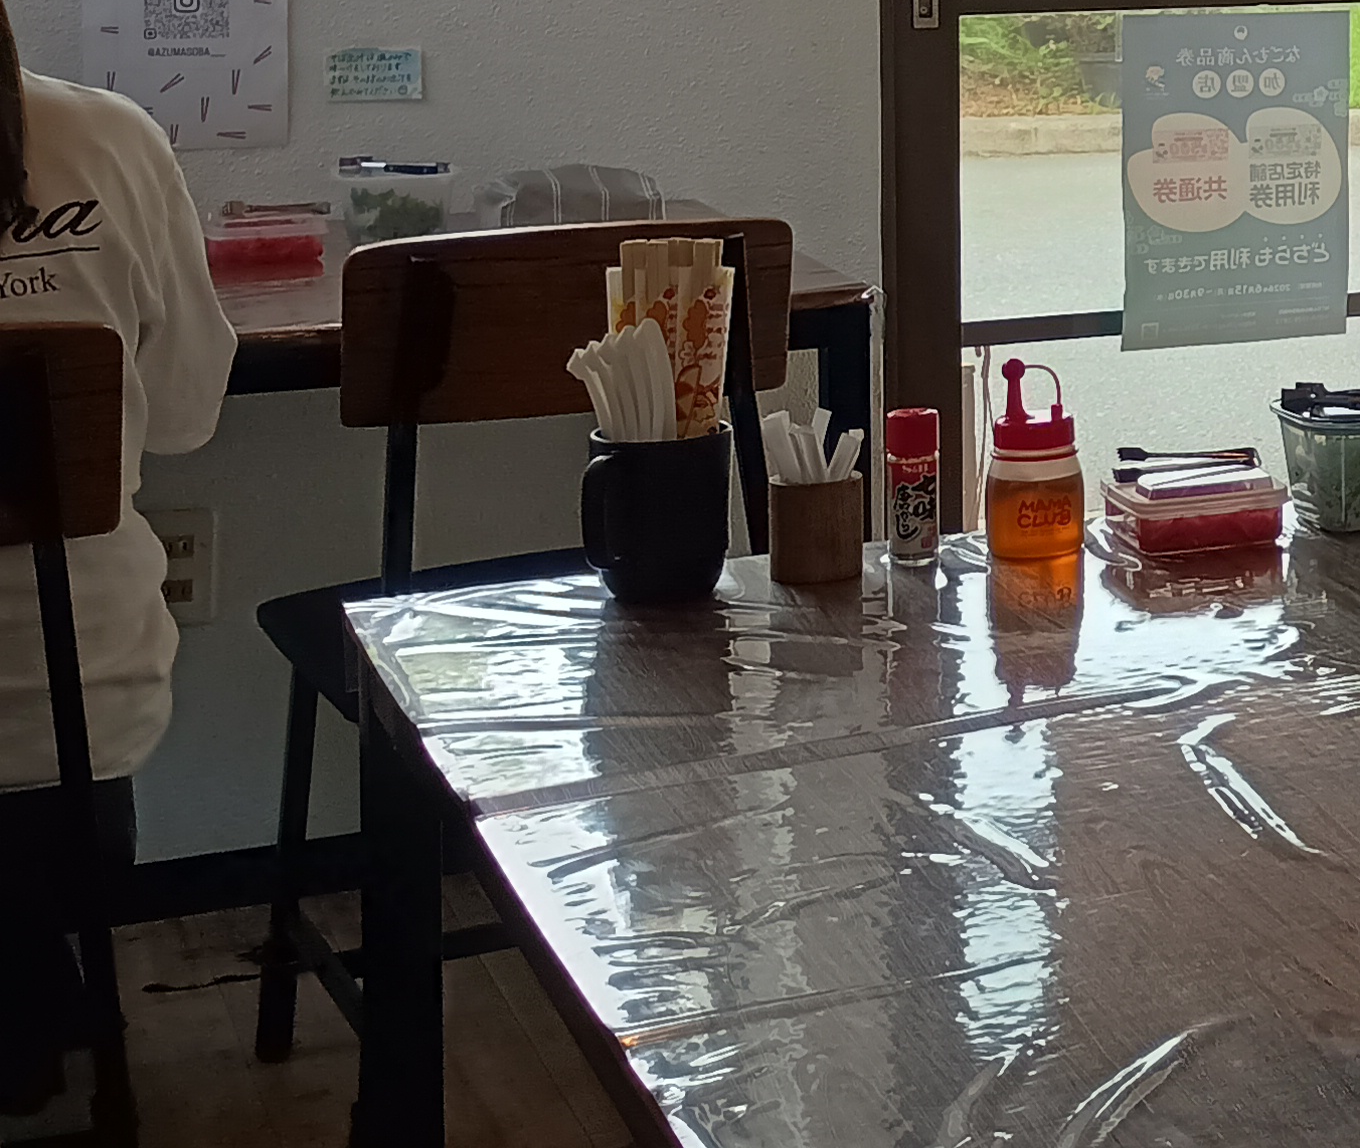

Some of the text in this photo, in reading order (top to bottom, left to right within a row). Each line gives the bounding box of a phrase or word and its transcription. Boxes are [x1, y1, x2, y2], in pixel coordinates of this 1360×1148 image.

[0, 267, 60, 299] York
[1018, 495, 1073, 515] MAMA
[1017, 509, 1072, 529] CLUB
